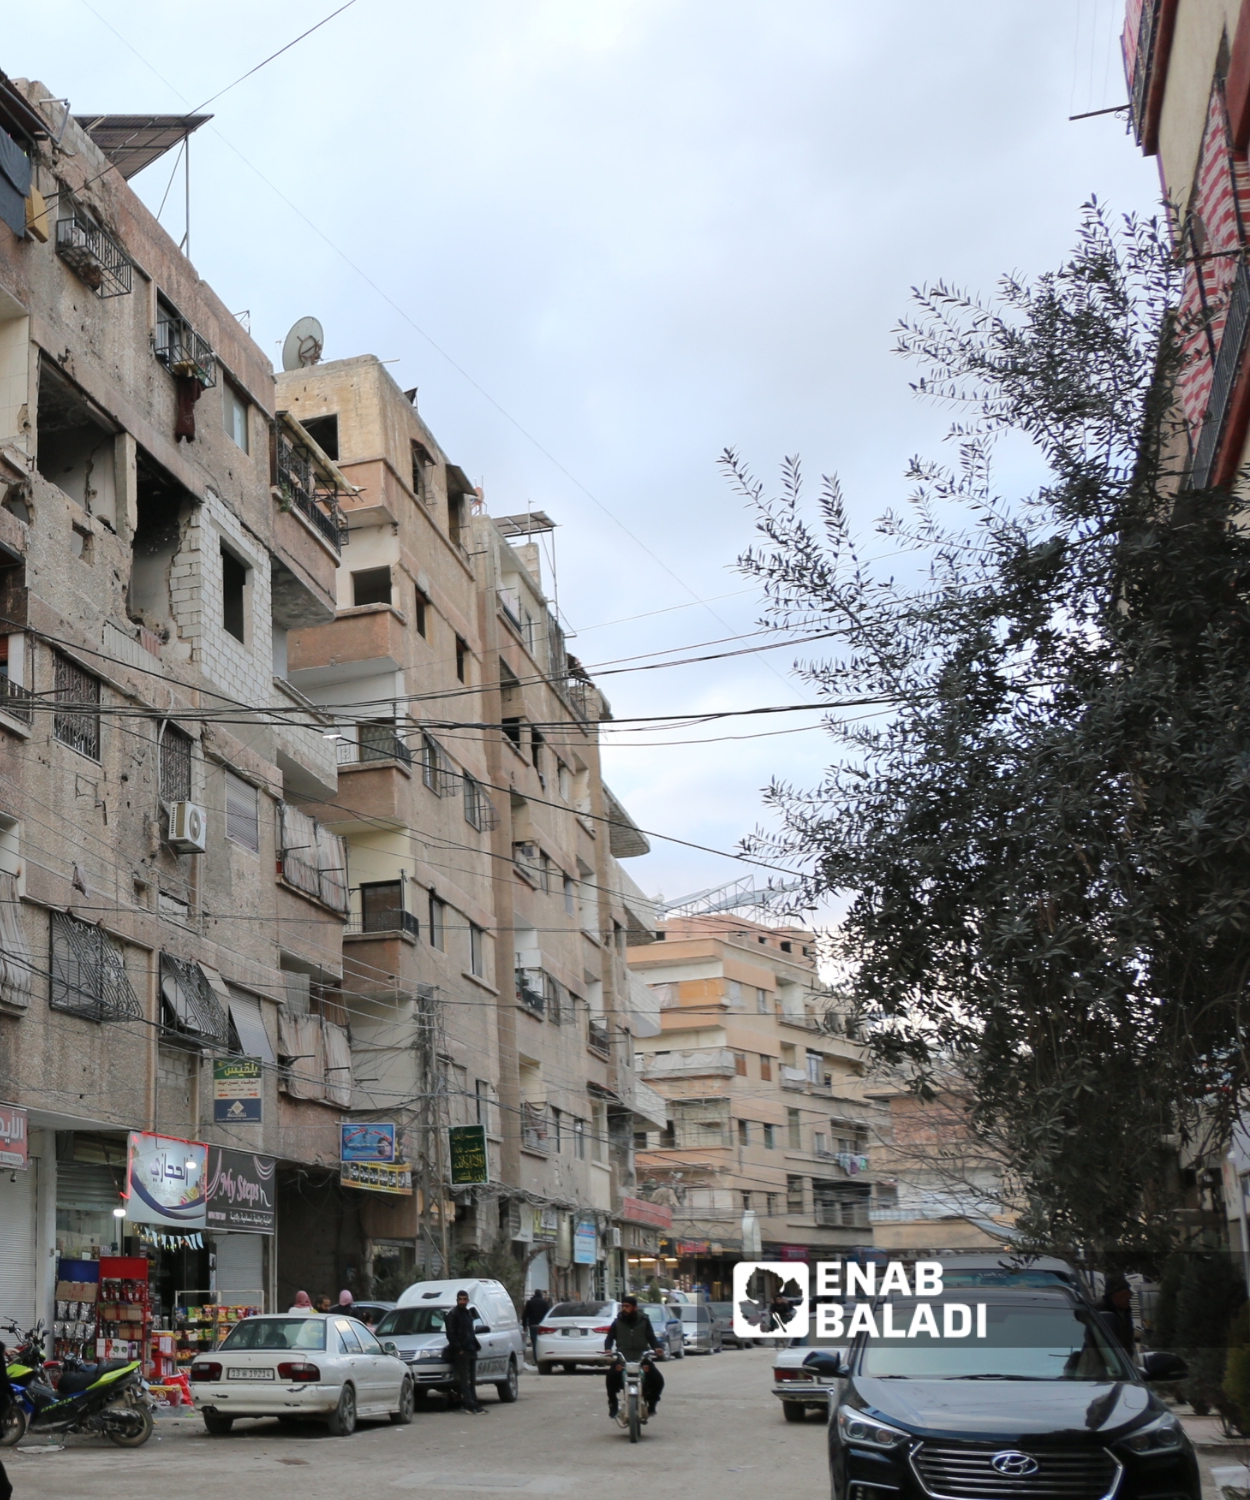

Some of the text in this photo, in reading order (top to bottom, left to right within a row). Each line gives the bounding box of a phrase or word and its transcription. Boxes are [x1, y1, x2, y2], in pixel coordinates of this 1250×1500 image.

[224, 1061, 258, 1077] بلقيس
[149, 1152, 189, 1187] الحجازي
[219, 1168, 260, 1207] My Steps
